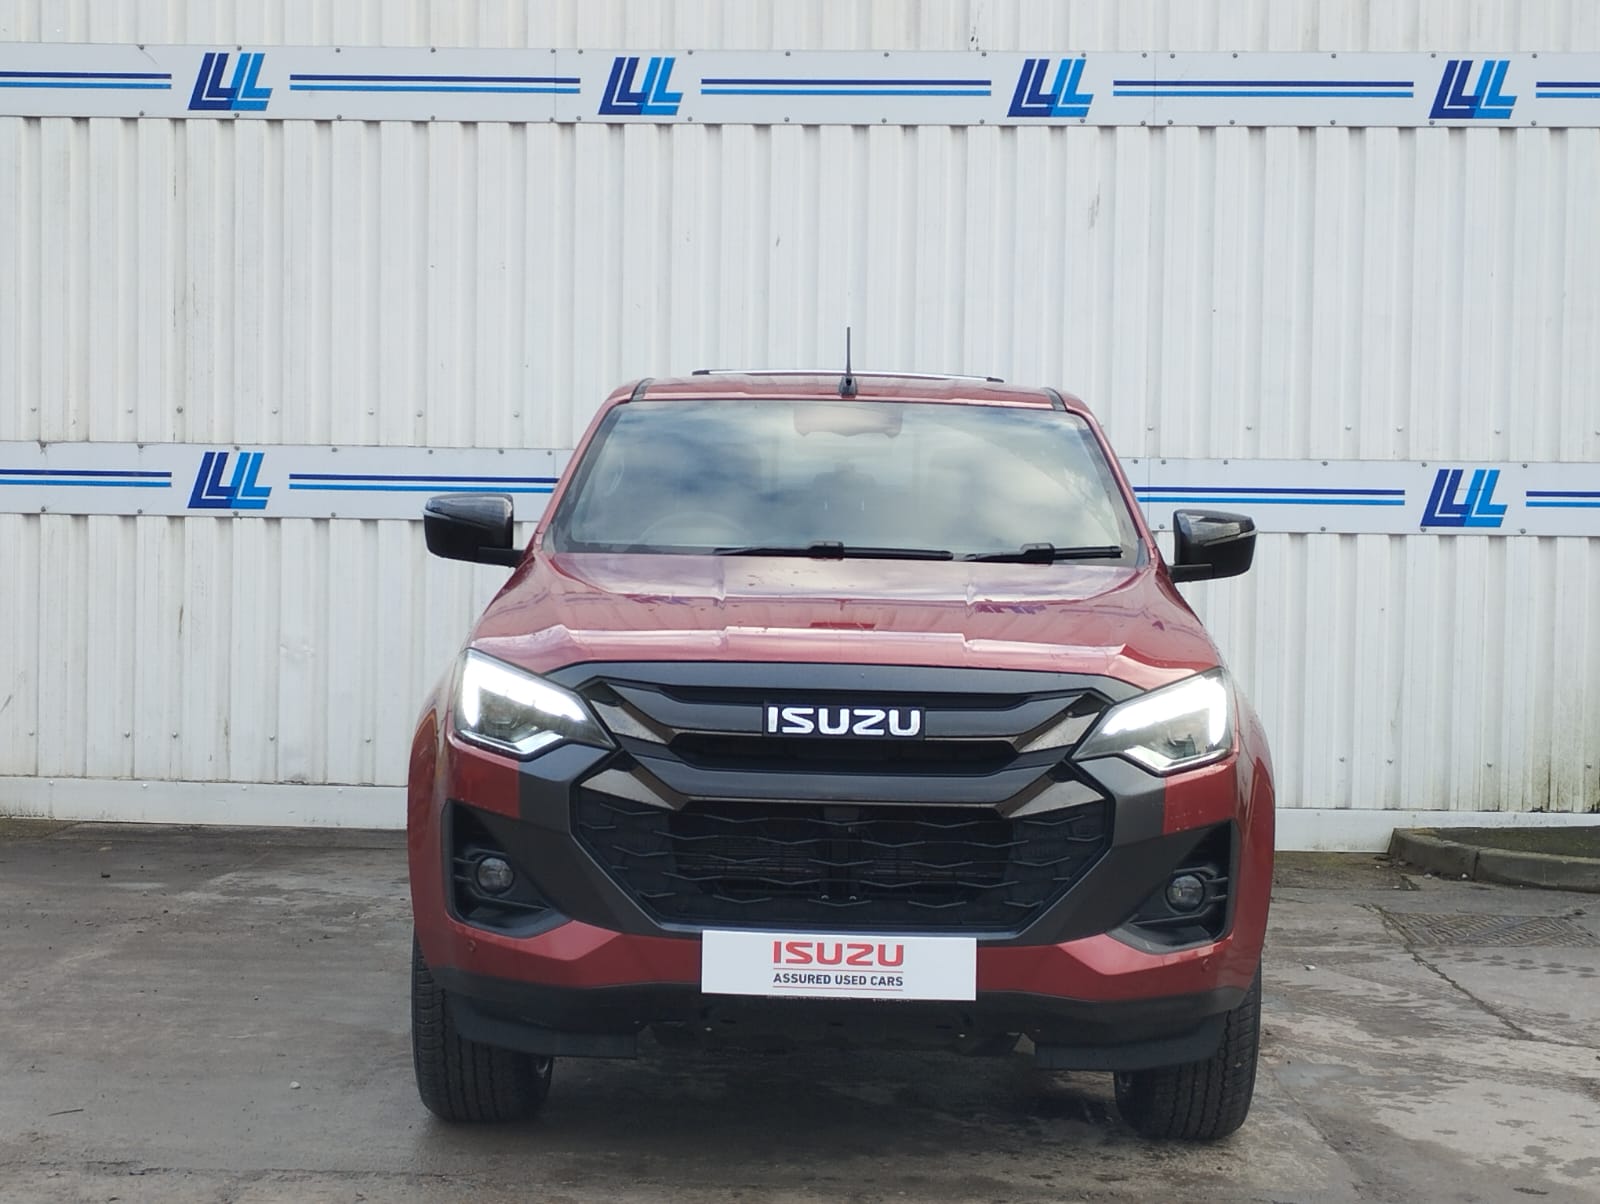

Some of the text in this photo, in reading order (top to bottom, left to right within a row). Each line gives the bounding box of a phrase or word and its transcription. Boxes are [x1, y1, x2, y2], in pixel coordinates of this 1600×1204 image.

[767, 706, 921, 737] ISUZU
[773, 941, 904, 967] ISUZU
[773, 973, 904, 987] ASSURED USED CARS
